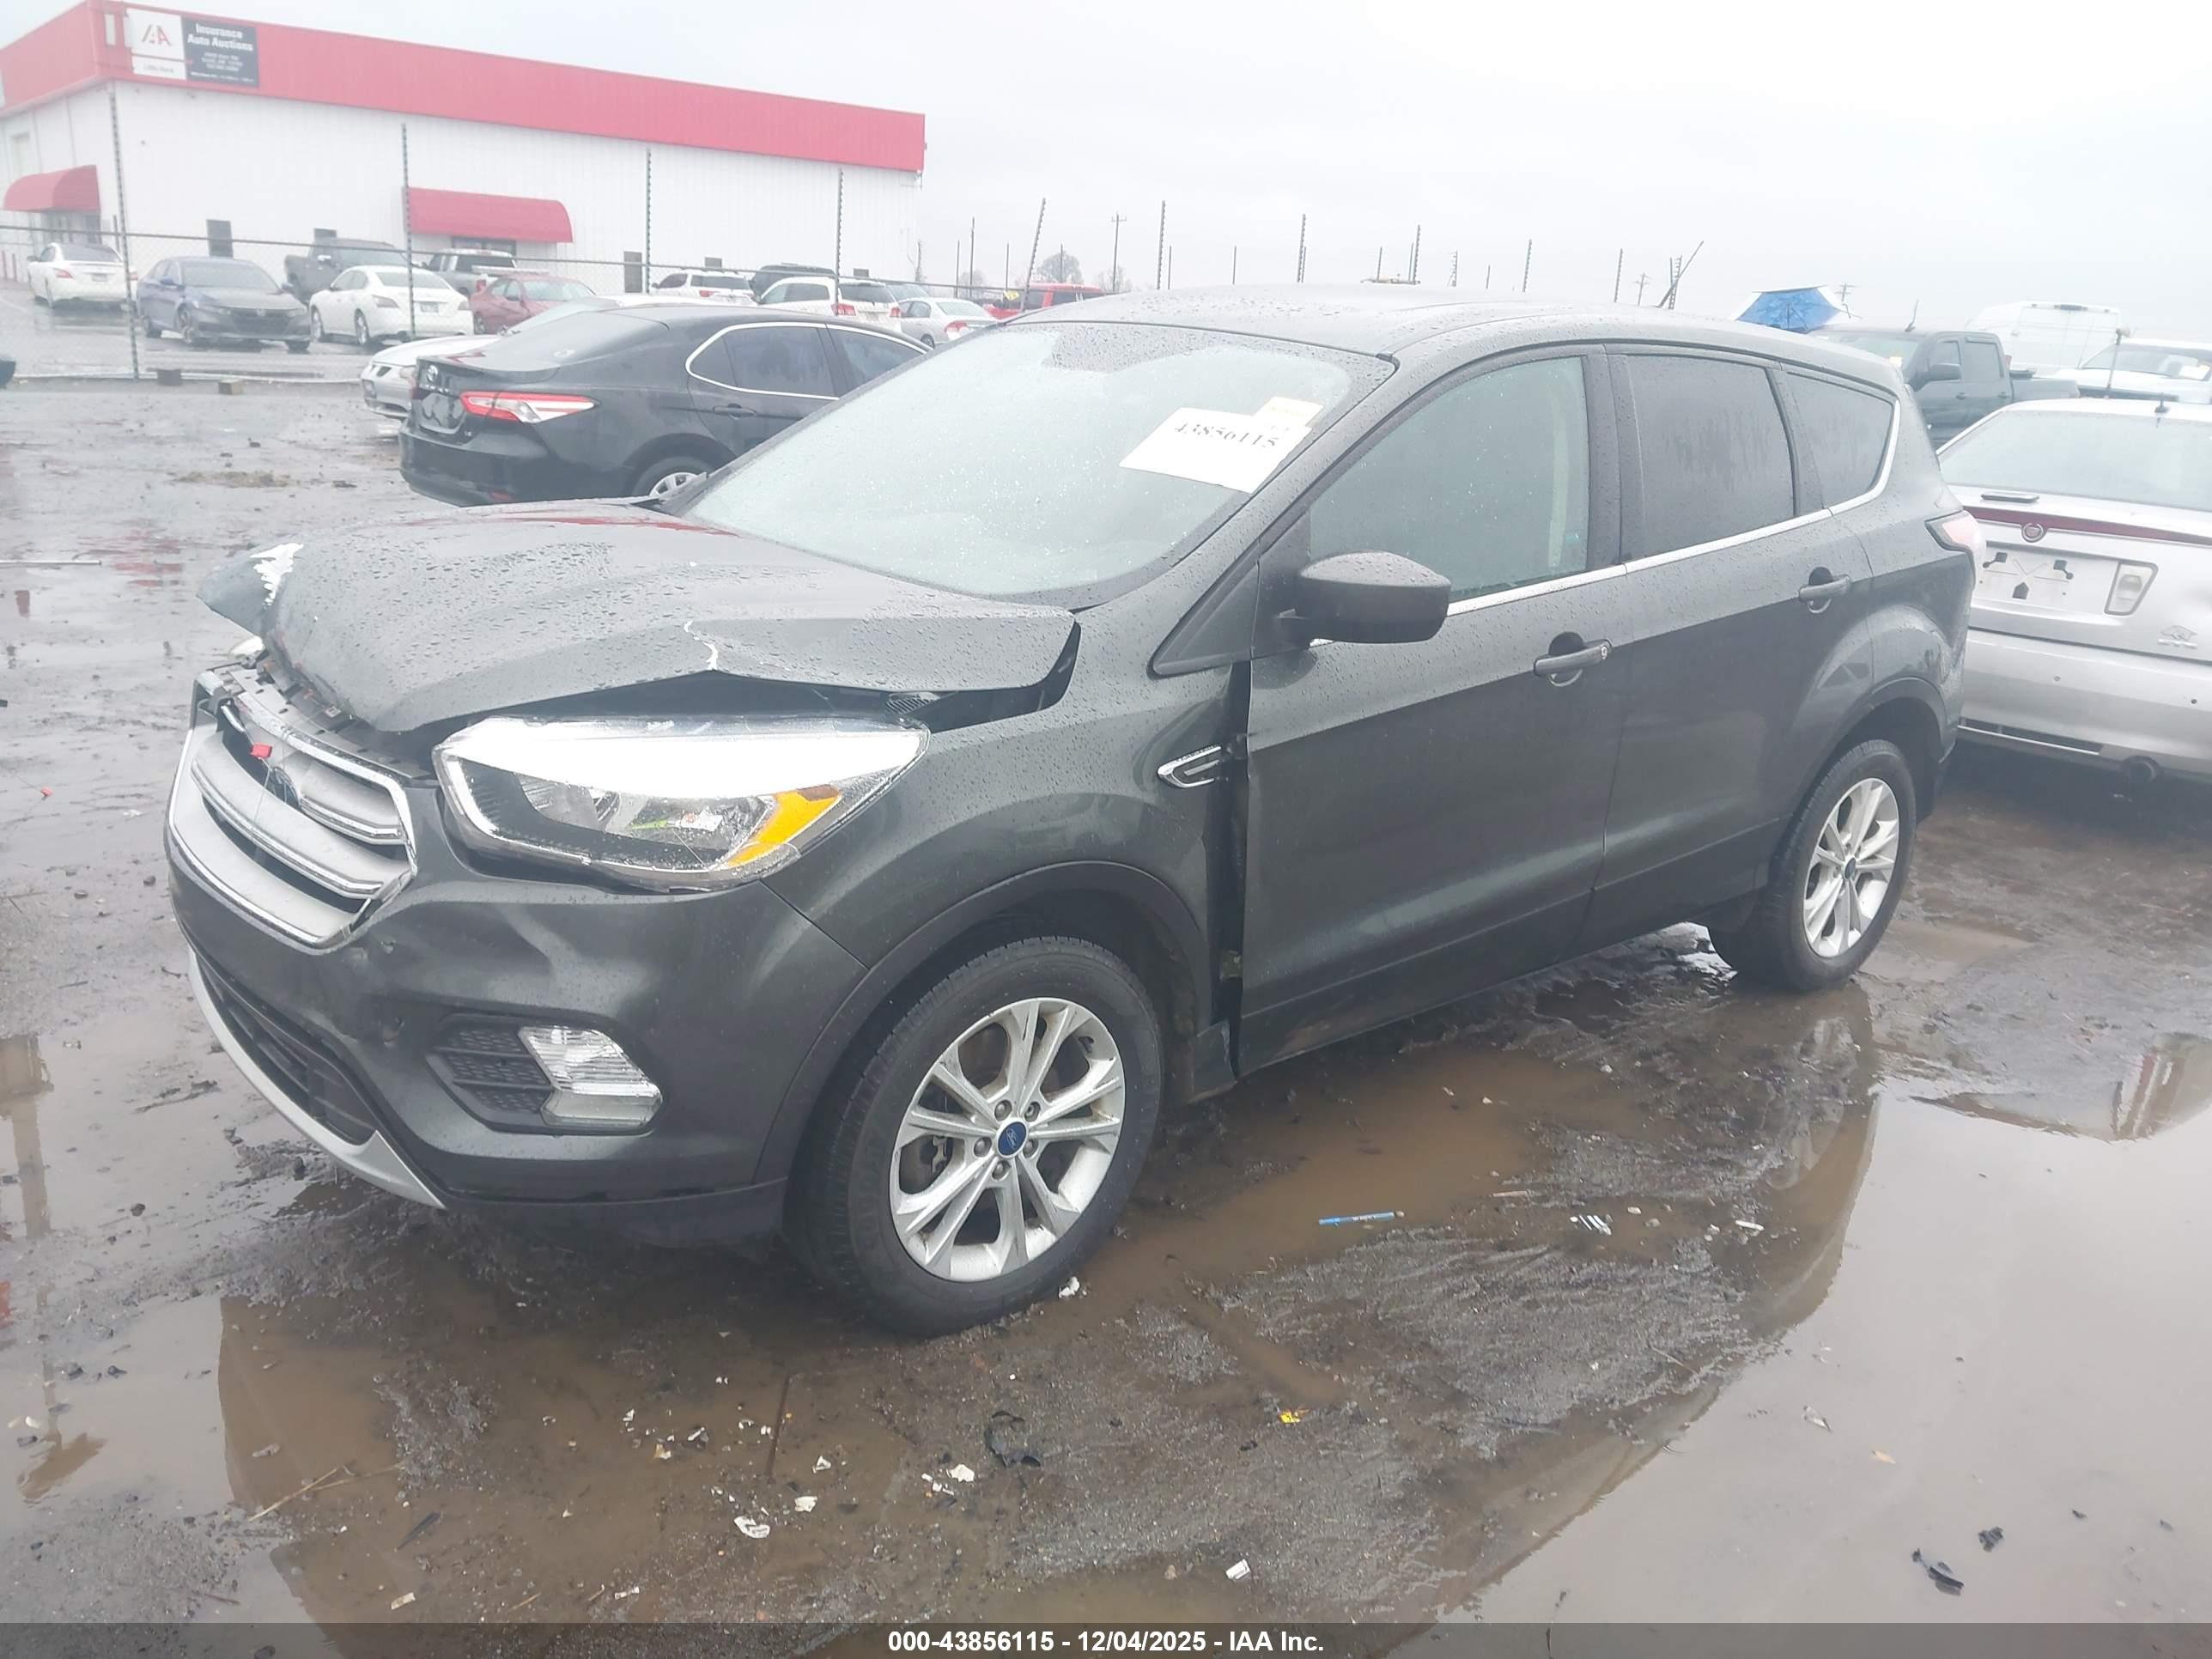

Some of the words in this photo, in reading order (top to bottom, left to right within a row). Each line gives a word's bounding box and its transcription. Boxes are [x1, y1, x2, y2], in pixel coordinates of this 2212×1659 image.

[195, 22, 243, 40] Insurance
[187, 33, 210, 46] Auto
[211, 37, 254, 52] Auctions
